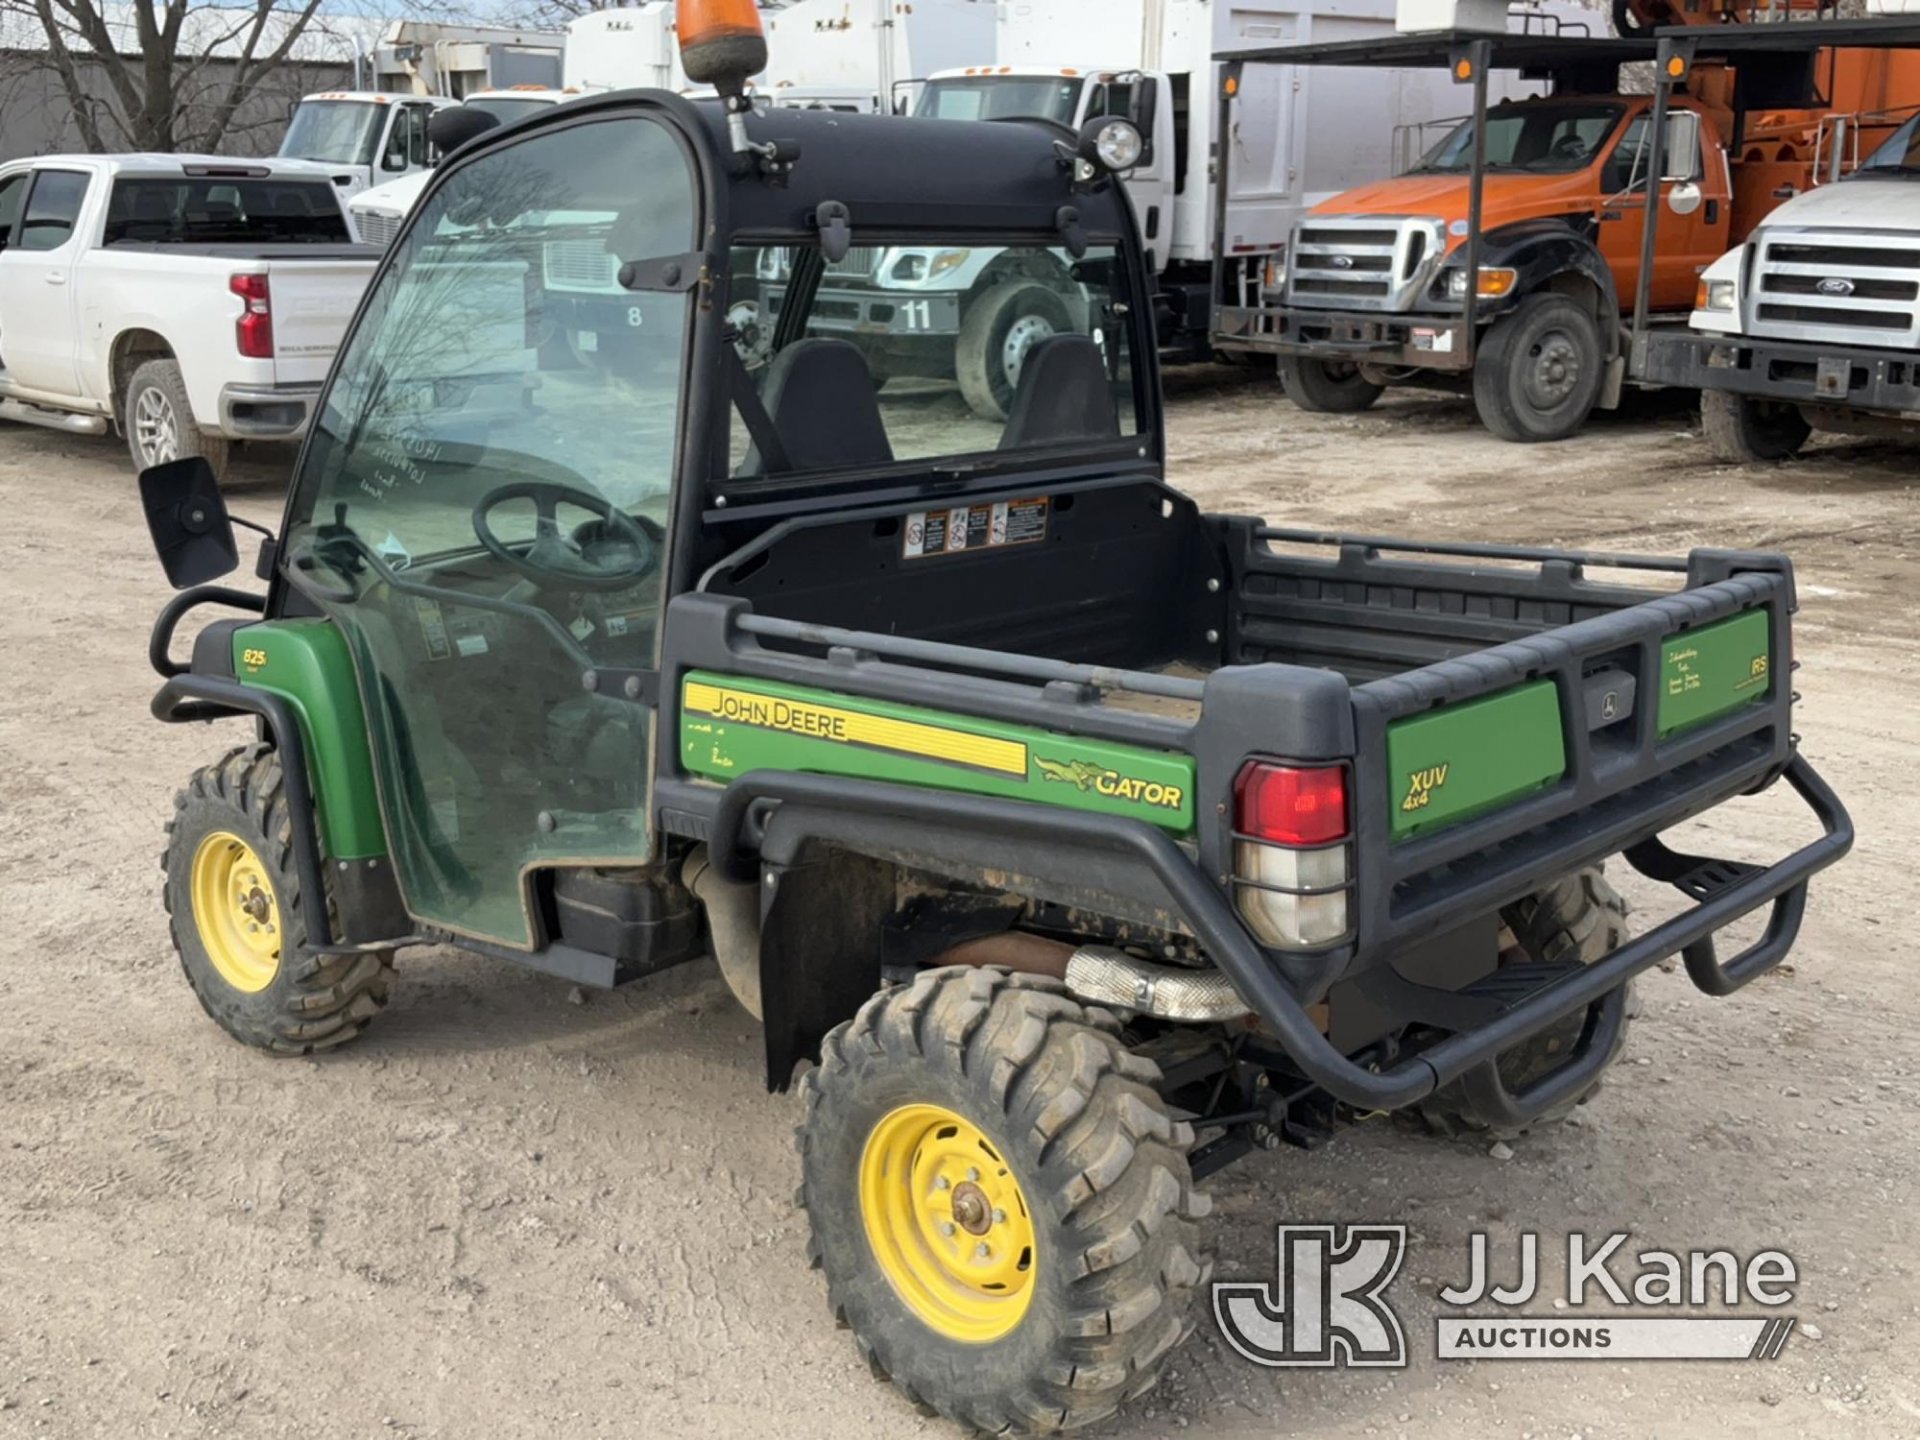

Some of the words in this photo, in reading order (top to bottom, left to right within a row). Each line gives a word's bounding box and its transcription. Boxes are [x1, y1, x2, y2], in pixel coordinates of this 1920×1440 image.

[627, 306, 643, 327] 8
[900, 299, 930, 329] 11
[712, 691, 768, 722] JOHN
[774, 702, 846, 737] DEERE
[1095, 770, 1182, 808] GATOR
[1410, 763, 1447, 794] XUV
[1402, 790, 1429, 811] 4x4
